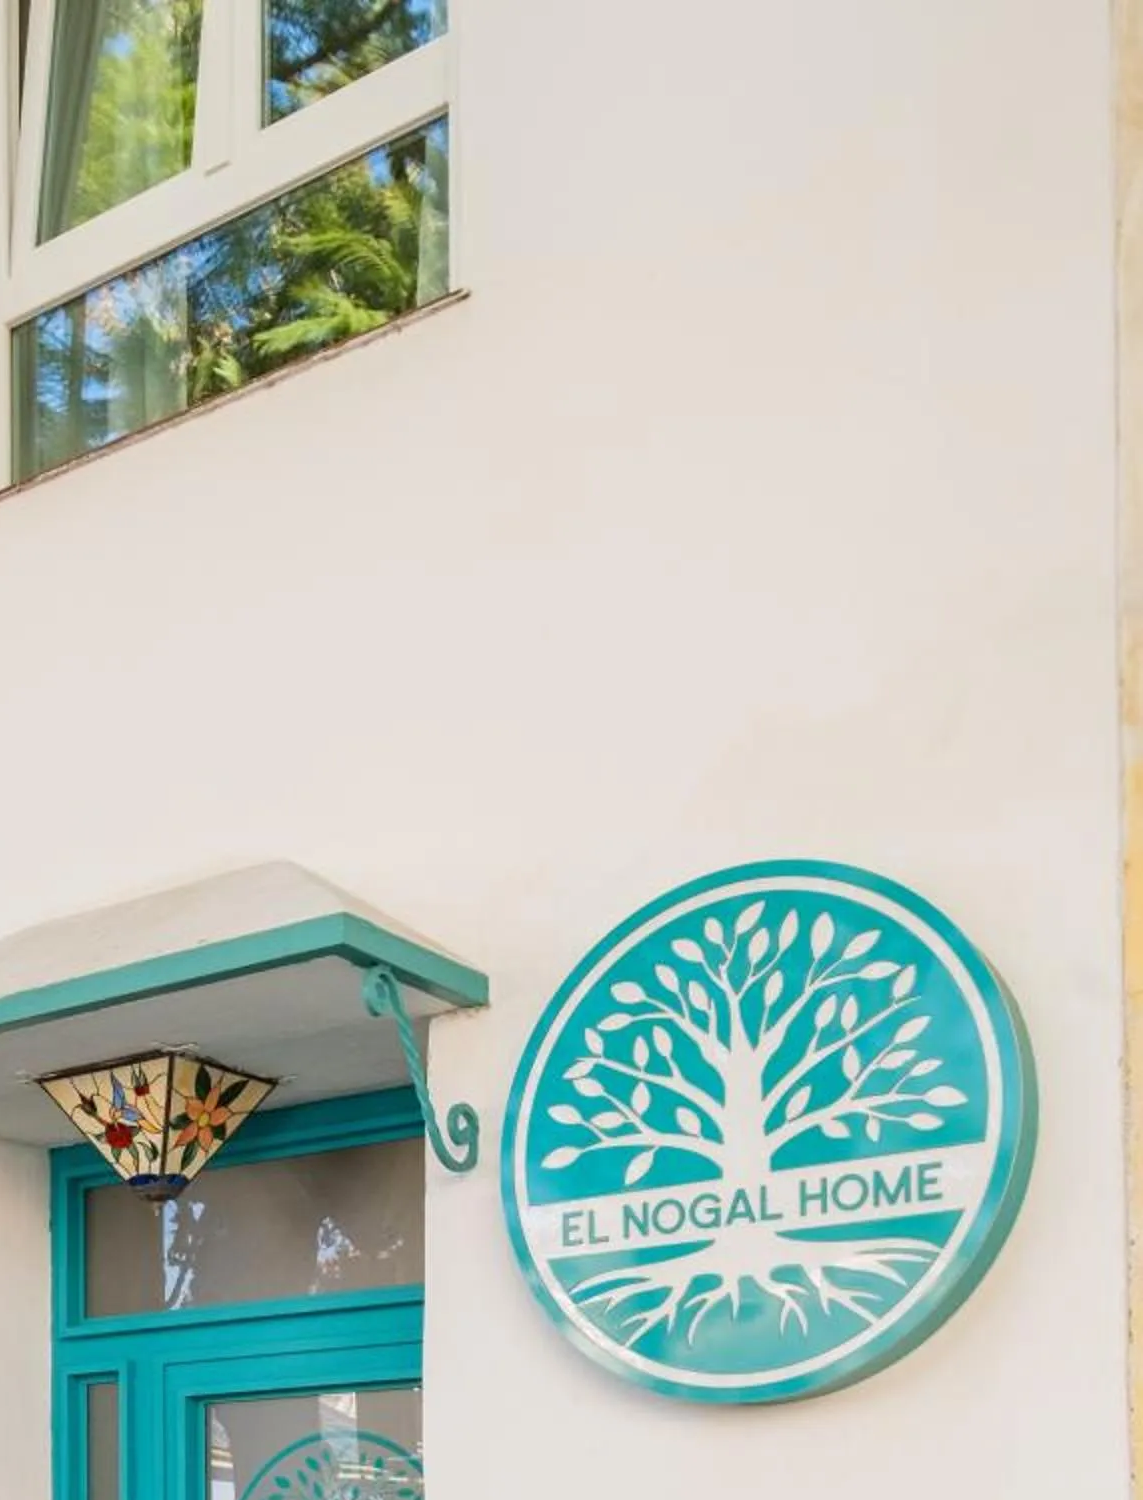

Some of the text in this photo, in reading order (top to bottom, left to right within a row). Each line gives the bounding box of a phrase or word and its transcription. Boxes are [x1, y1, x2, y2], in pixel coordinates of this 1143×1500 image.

[561, 1161, 944, 1247] EL NOGAL HOME
